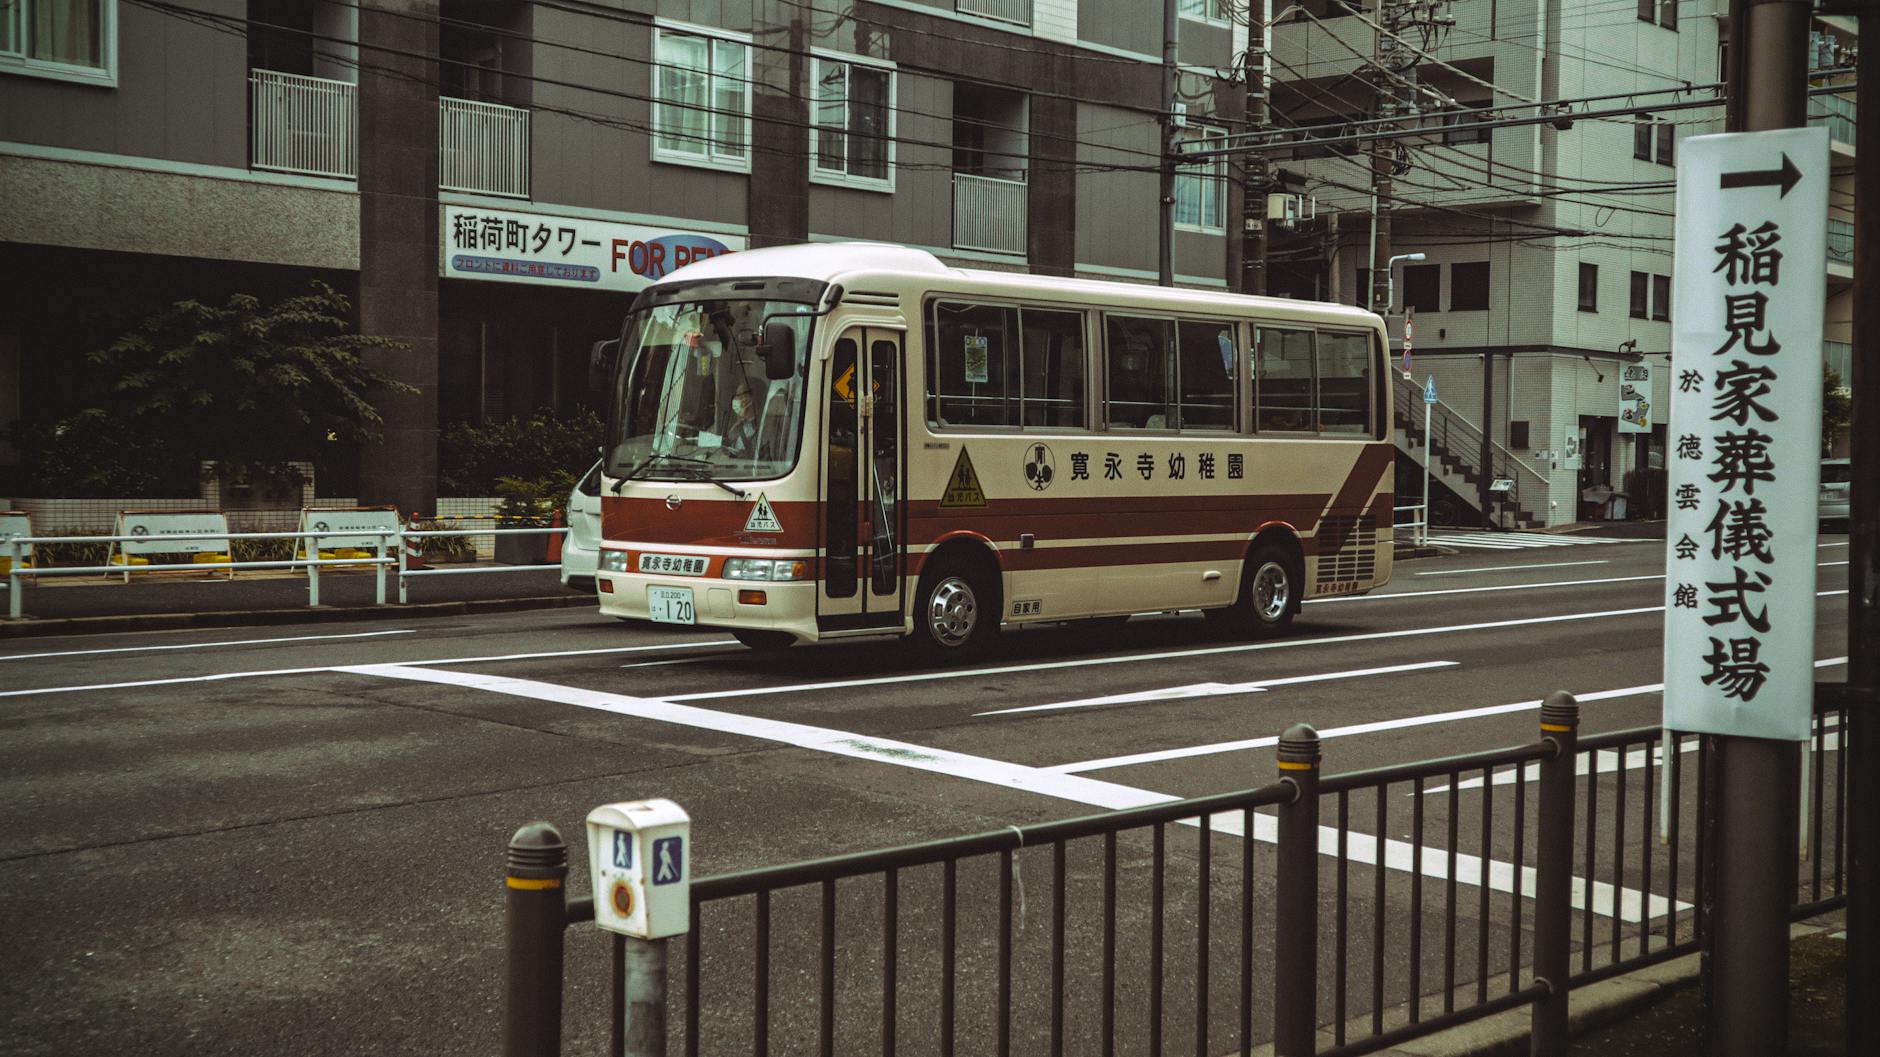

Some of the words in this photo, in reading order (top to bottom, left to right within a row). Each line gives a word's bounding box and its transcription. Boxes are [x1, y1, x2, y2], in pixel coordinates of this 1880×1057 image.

[453, 213, 601, 256] 稲荷町タワー
[611, 238, 666, 277] FOR
[1070, 450, 1245, 481] 寛永寺幼稚園
[1701, 220, 1785, 702] 稲見家葬儀式場
[641, 556, 705, 573] 寛永寺幼稚園
[1013, 601, 1040, 614] 自家用
